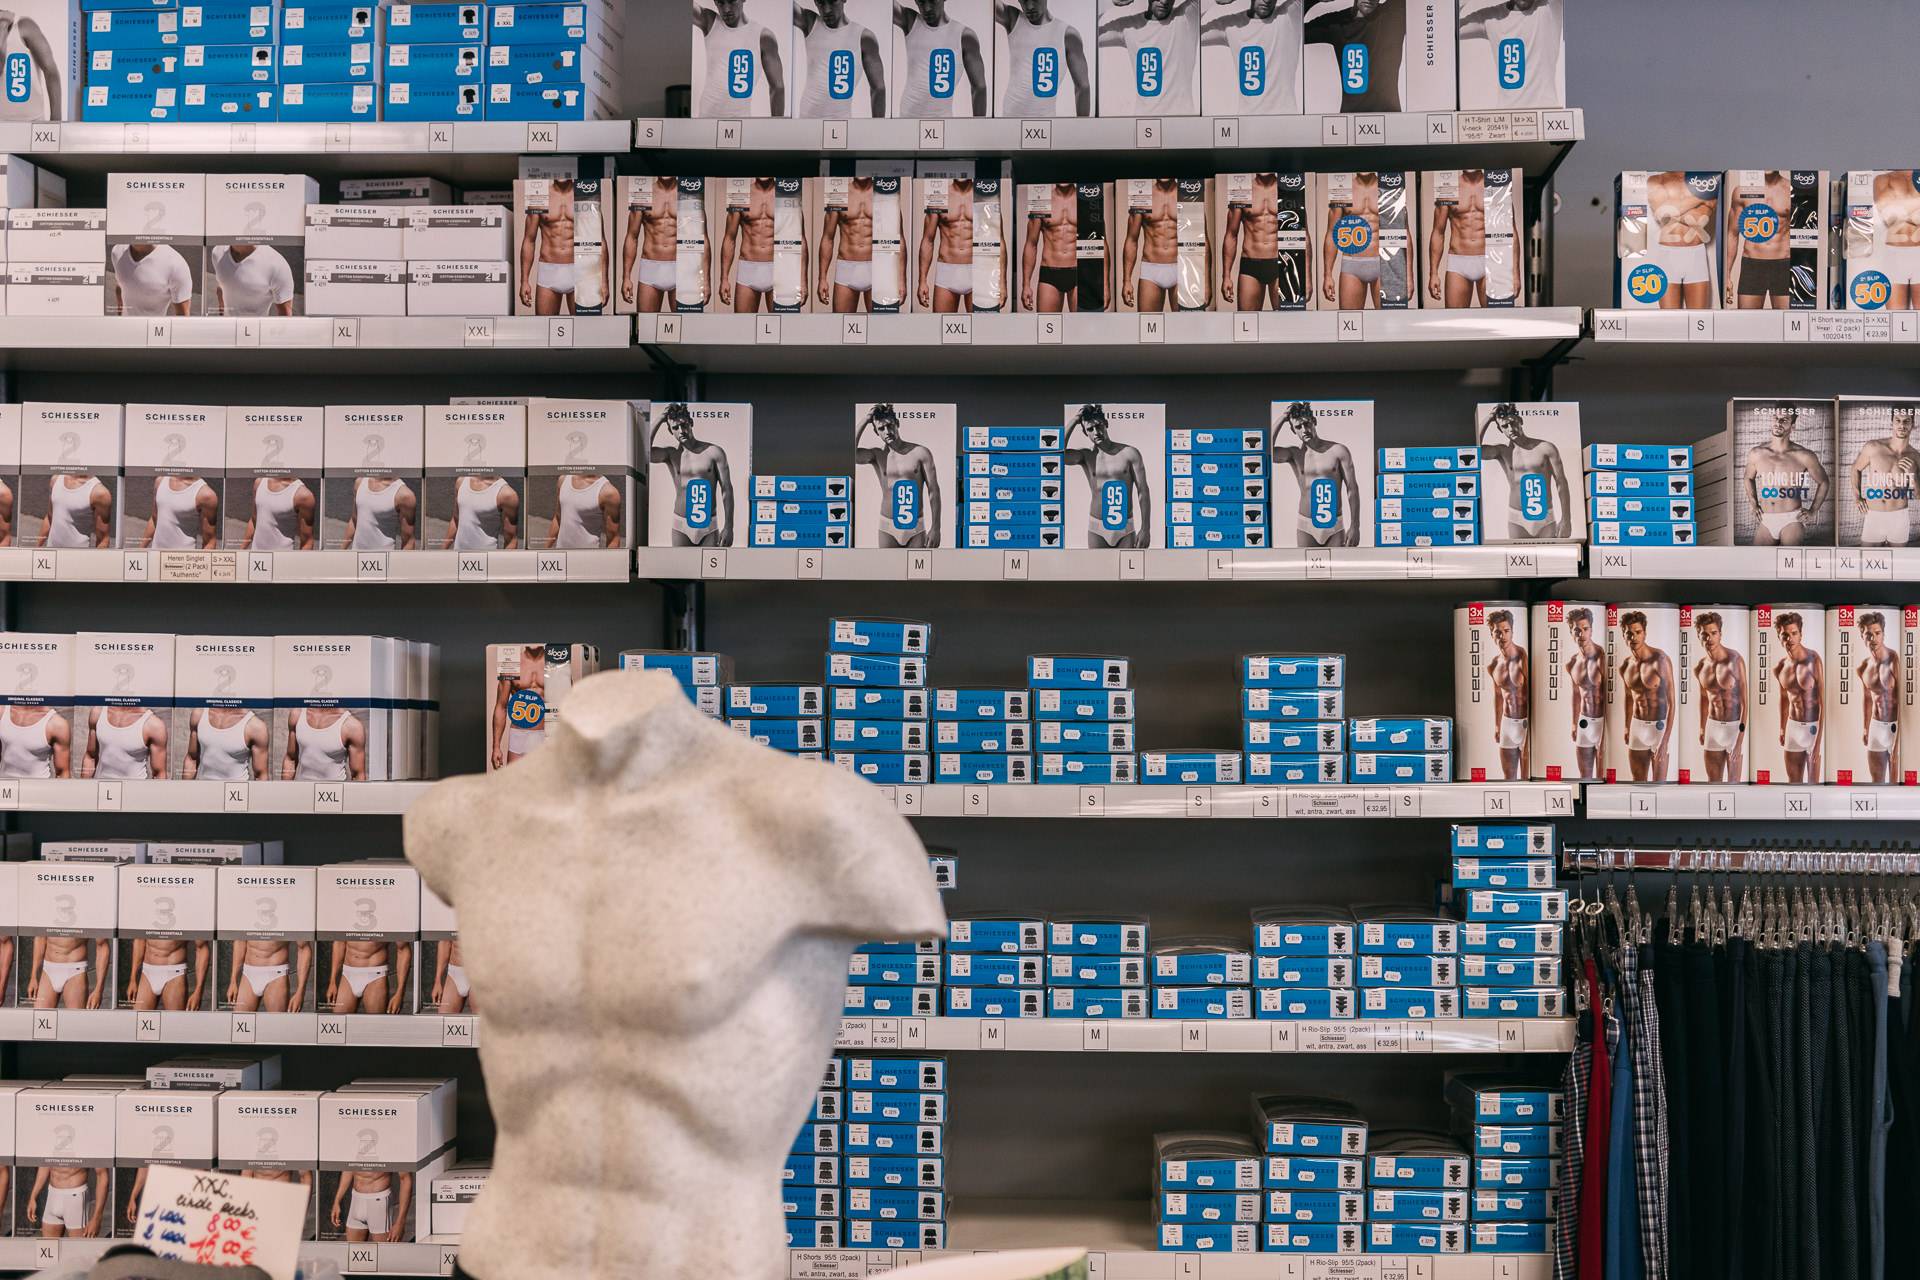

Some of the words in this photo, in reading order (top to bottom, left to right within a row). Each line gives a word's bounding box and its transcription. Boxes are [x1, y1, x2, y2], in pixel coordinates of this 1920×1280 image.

[1348, 50, 1362, 68] 95
[1504, 45, 1519, 63] 95
[734, 55, 748, 73] 95
[1038, 53, 1052, 72] 95
[11, 59, 25, 77] 95
[1347, 69, 1363, 88] 5
[1504, 64, 1520, 83] 5
[11, 77, 26, 97] 5
[733, 74, 748, 93] 5
[1038, 73, 1053, 92] 5
[1548, 120, 1569, 130] XXL
[434, 131, 447, 141] XL
[832, 129, 837, 139] L
[925, 129, 938, 138] XL
[226, 182, 285, 190] SCHIESSER
[1744, 218, 1774, 237] 50
[1337, 228, 1367, 247] 50
[1632, 275, 1660, 294] 50
[1856, 282, 1886, 303] 50
[848, 324, 862, 333] XL
[1600, 320, 1622, 329] XXL
[1791, 321, 1800, 331] M
[338, 327, 352, 337] XL
[557, 327, 564, 337] S
[1761, 472, 1788, 485] LONG
[1791, 472, 1810, 486] LIFE
[1525, 478, 1541, 497] 95
[692, 485, 706, 503] 95
[1107, 486, 1122, 505] 95
[1526, 498, 1542, 516] 5
[691, 504, 706, 523] 5
[1107, 506, 1122, 525] 5
[129, 560, 142, 570] XL
[462, 561, 483, 570] XXL
[806, 558, 813, 568] S
[1012, 559, 1020, 569] M
[1605, 556, 1627, 566] XXL
[1841, 558, 1854, 568] XL
[1470, 608, 1482, 616] 3x
[1549, 605, 1563, 614] 3x
[1759, 610, 1770, 619] 3x
[1840, 609, 1853, 618] 3x
[1905, 610, 1917, 619] 3x
[1472, 629, 1480, 702] ceceba
[1549, 627, 1558, 700] ceceba
[1840, 631, 1848, 704] ceceba
[512, 701, 540, 722] 50
[2, 788, 11, 798] M
[318, 792, 339, 801] XXL
[1088, 796, 1095, 805] S
[1552, 798, 1564, 808] M
[1718, 800, 1727, 810] L
[137, 876, 194, 884] SCHIESSER
[38, 1019, 52, 1029] XL
[321, 1024, 342, 1033] XXL
[909, 1028, 918, 1038] M
[1190, 1030, 1199, 1040] M
[135, 1105, 192, 1113] SCHIESSER
[40, 1248, 53, 1258] XL
[1090, 1262, 1096, 1271] L
[1289, 1264, 1294, 1273] L
